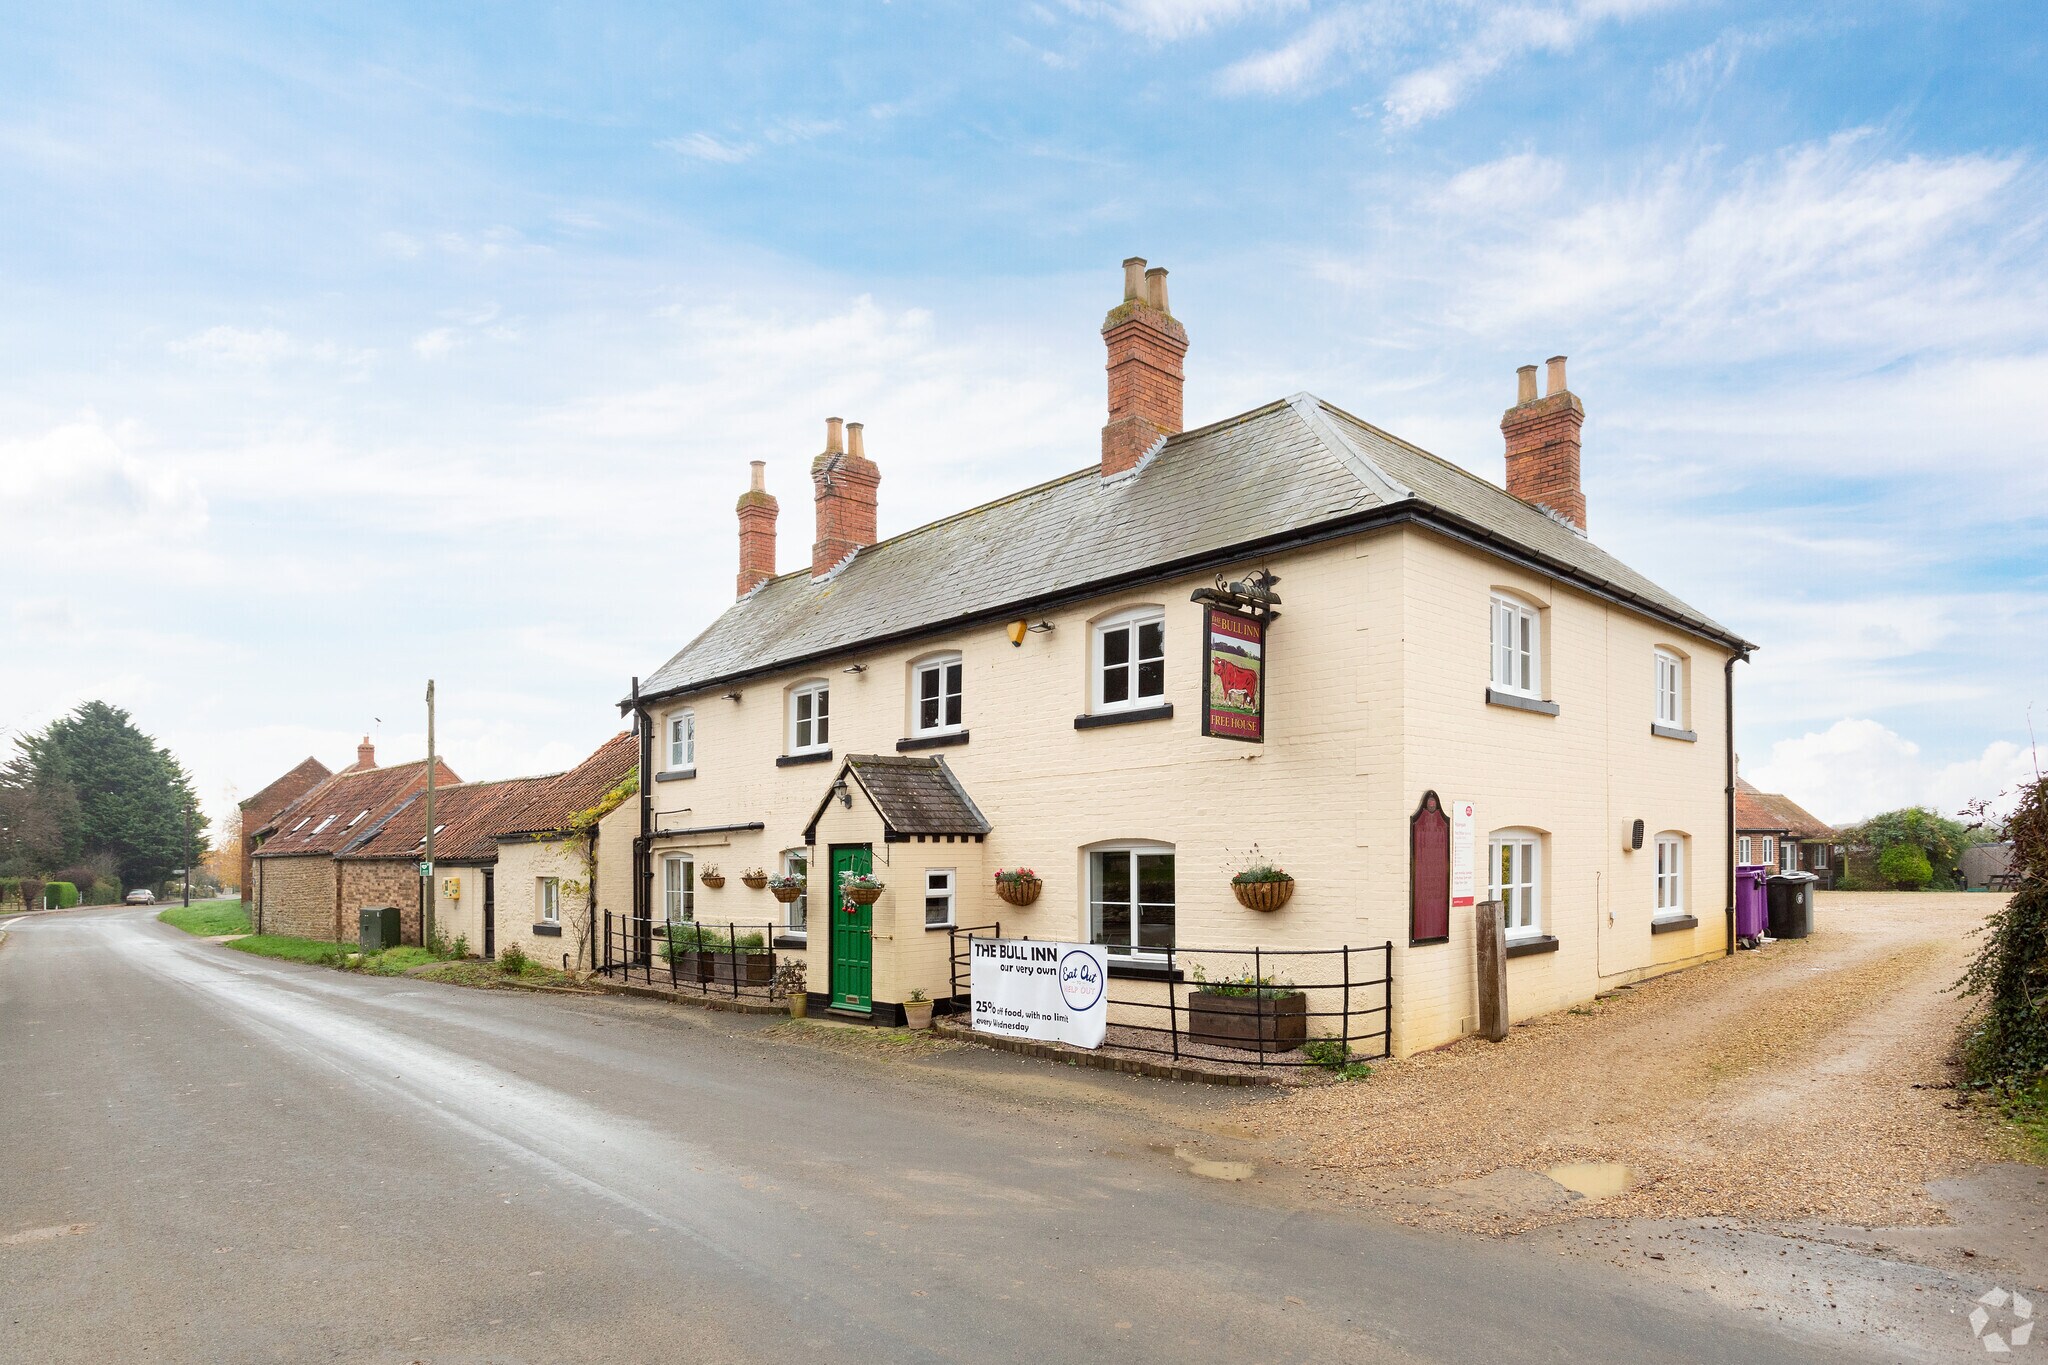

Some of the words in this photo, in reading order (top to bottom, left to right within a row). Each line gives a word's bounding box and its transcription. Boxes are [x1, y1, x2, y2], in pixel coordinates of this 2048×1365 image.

[1221, 618, 1243, 635] BULL
[1243, 624, 1260, 638] INN
[1211, 714, 1230, 728] FREE
[1231, 717, 1257, 731] HOUSE
[975, 943, 997, 958] THE
[1000, 944, 1028, 961] BULL
[1031, 946, 1058, 962] INN
[1000, 964, 1013, 973] our
[1016, 965, 1034, 976] very
[1036, 966, 1057, 976] own
[1062, 966, 1078, 981] Eat
[1080, 964, 1097, 984] Out
[1080, 986, 1096, 995] OUT
[975, 1000, 997, 1015] 25%
[996, 1007, 1004, 1016] off
[1004, 1007, 1024, 1018] food,
[1025, 1011, 1041, 1020] with
[1041, 1013, 1052, 1021] no
[1054, 1012, 1069, 1023] limit
[976, 1017, 993, 1027] every
